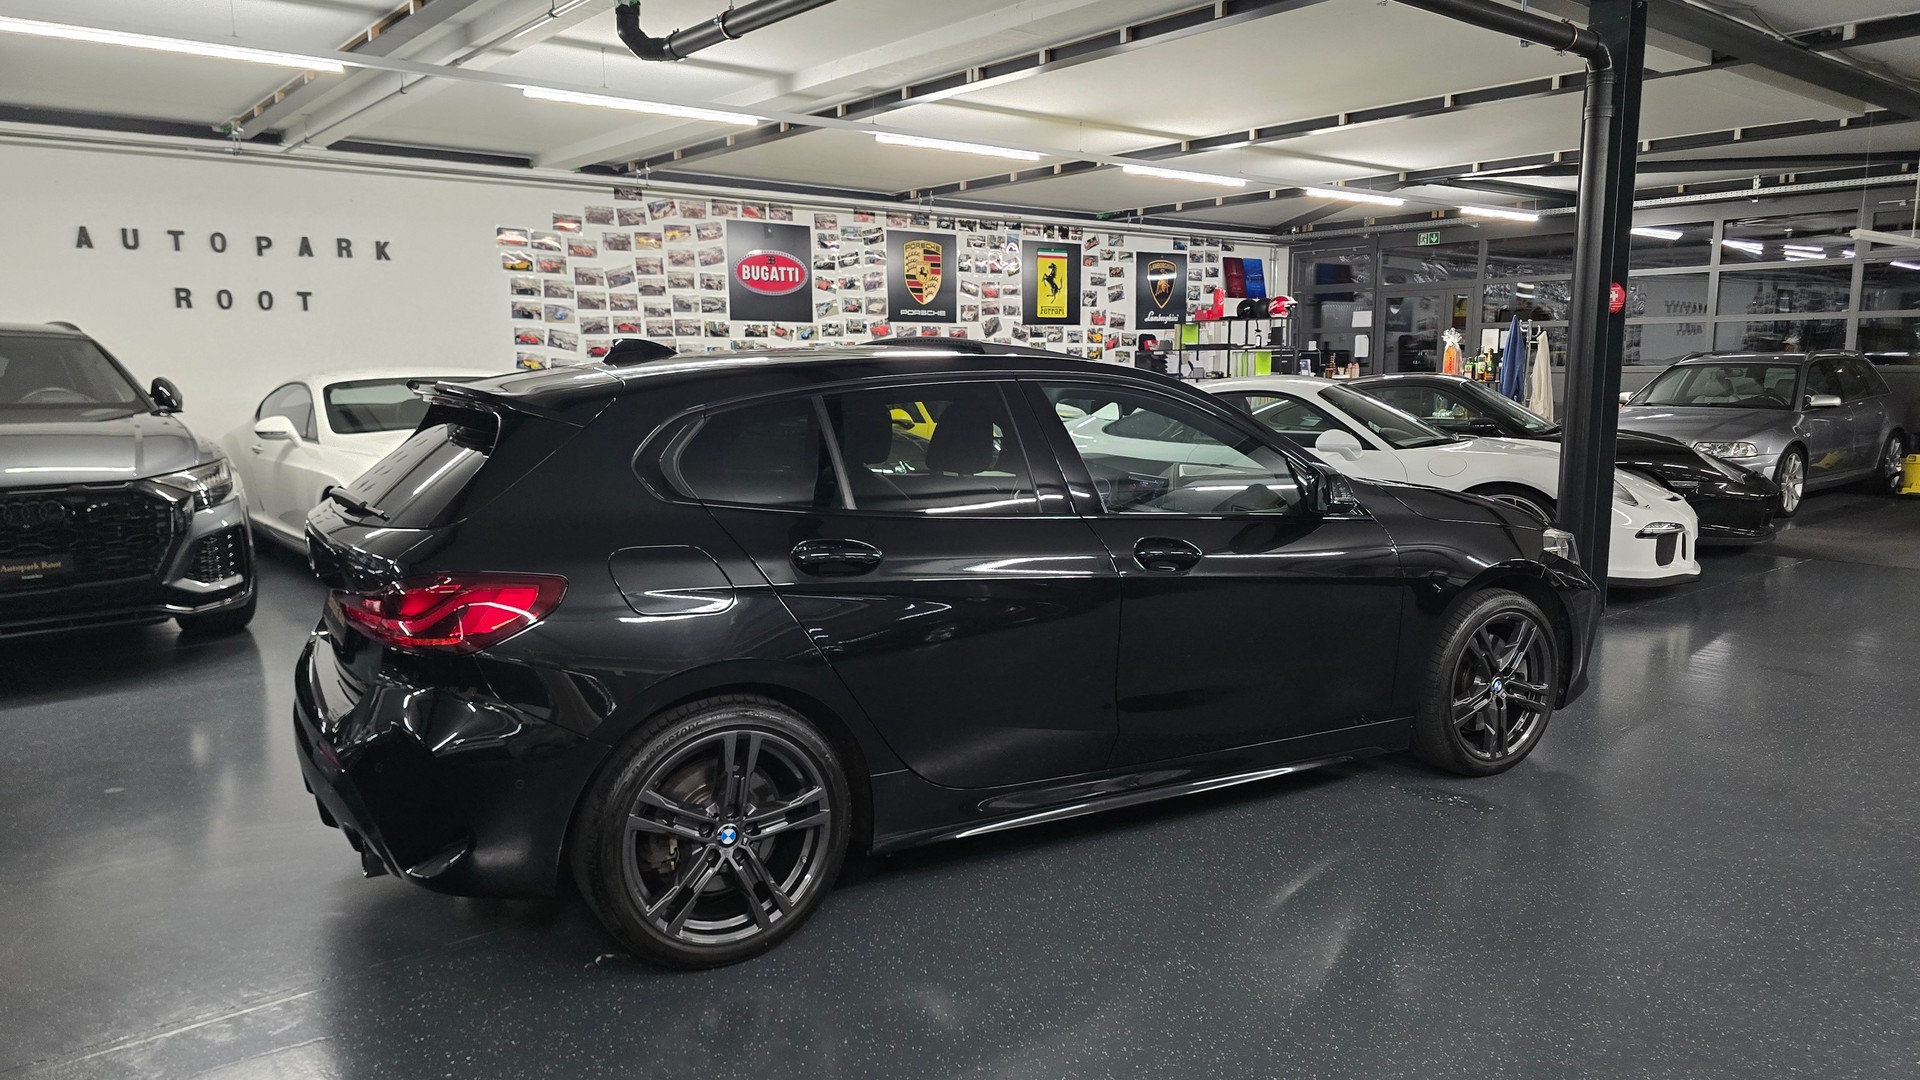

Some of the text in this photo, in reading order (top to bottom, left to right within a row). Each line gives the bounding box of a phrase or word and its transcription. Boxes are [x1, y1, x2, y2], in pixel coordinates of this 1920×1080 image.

[76, 226, 392, 262] AUTOPARK
[904, 242, 941, 252] PORSCHE
[742, 264, 800, 283] BUGATTI
[174, 287, 313, 312] ROOT
[900, 309, 946, 317] PORSCHE
[1040, 306, 1065, 315] Ferrari
[1144, 310, 1179, 324] Lamborghini
[0, 562, 39, 573] Autopark
